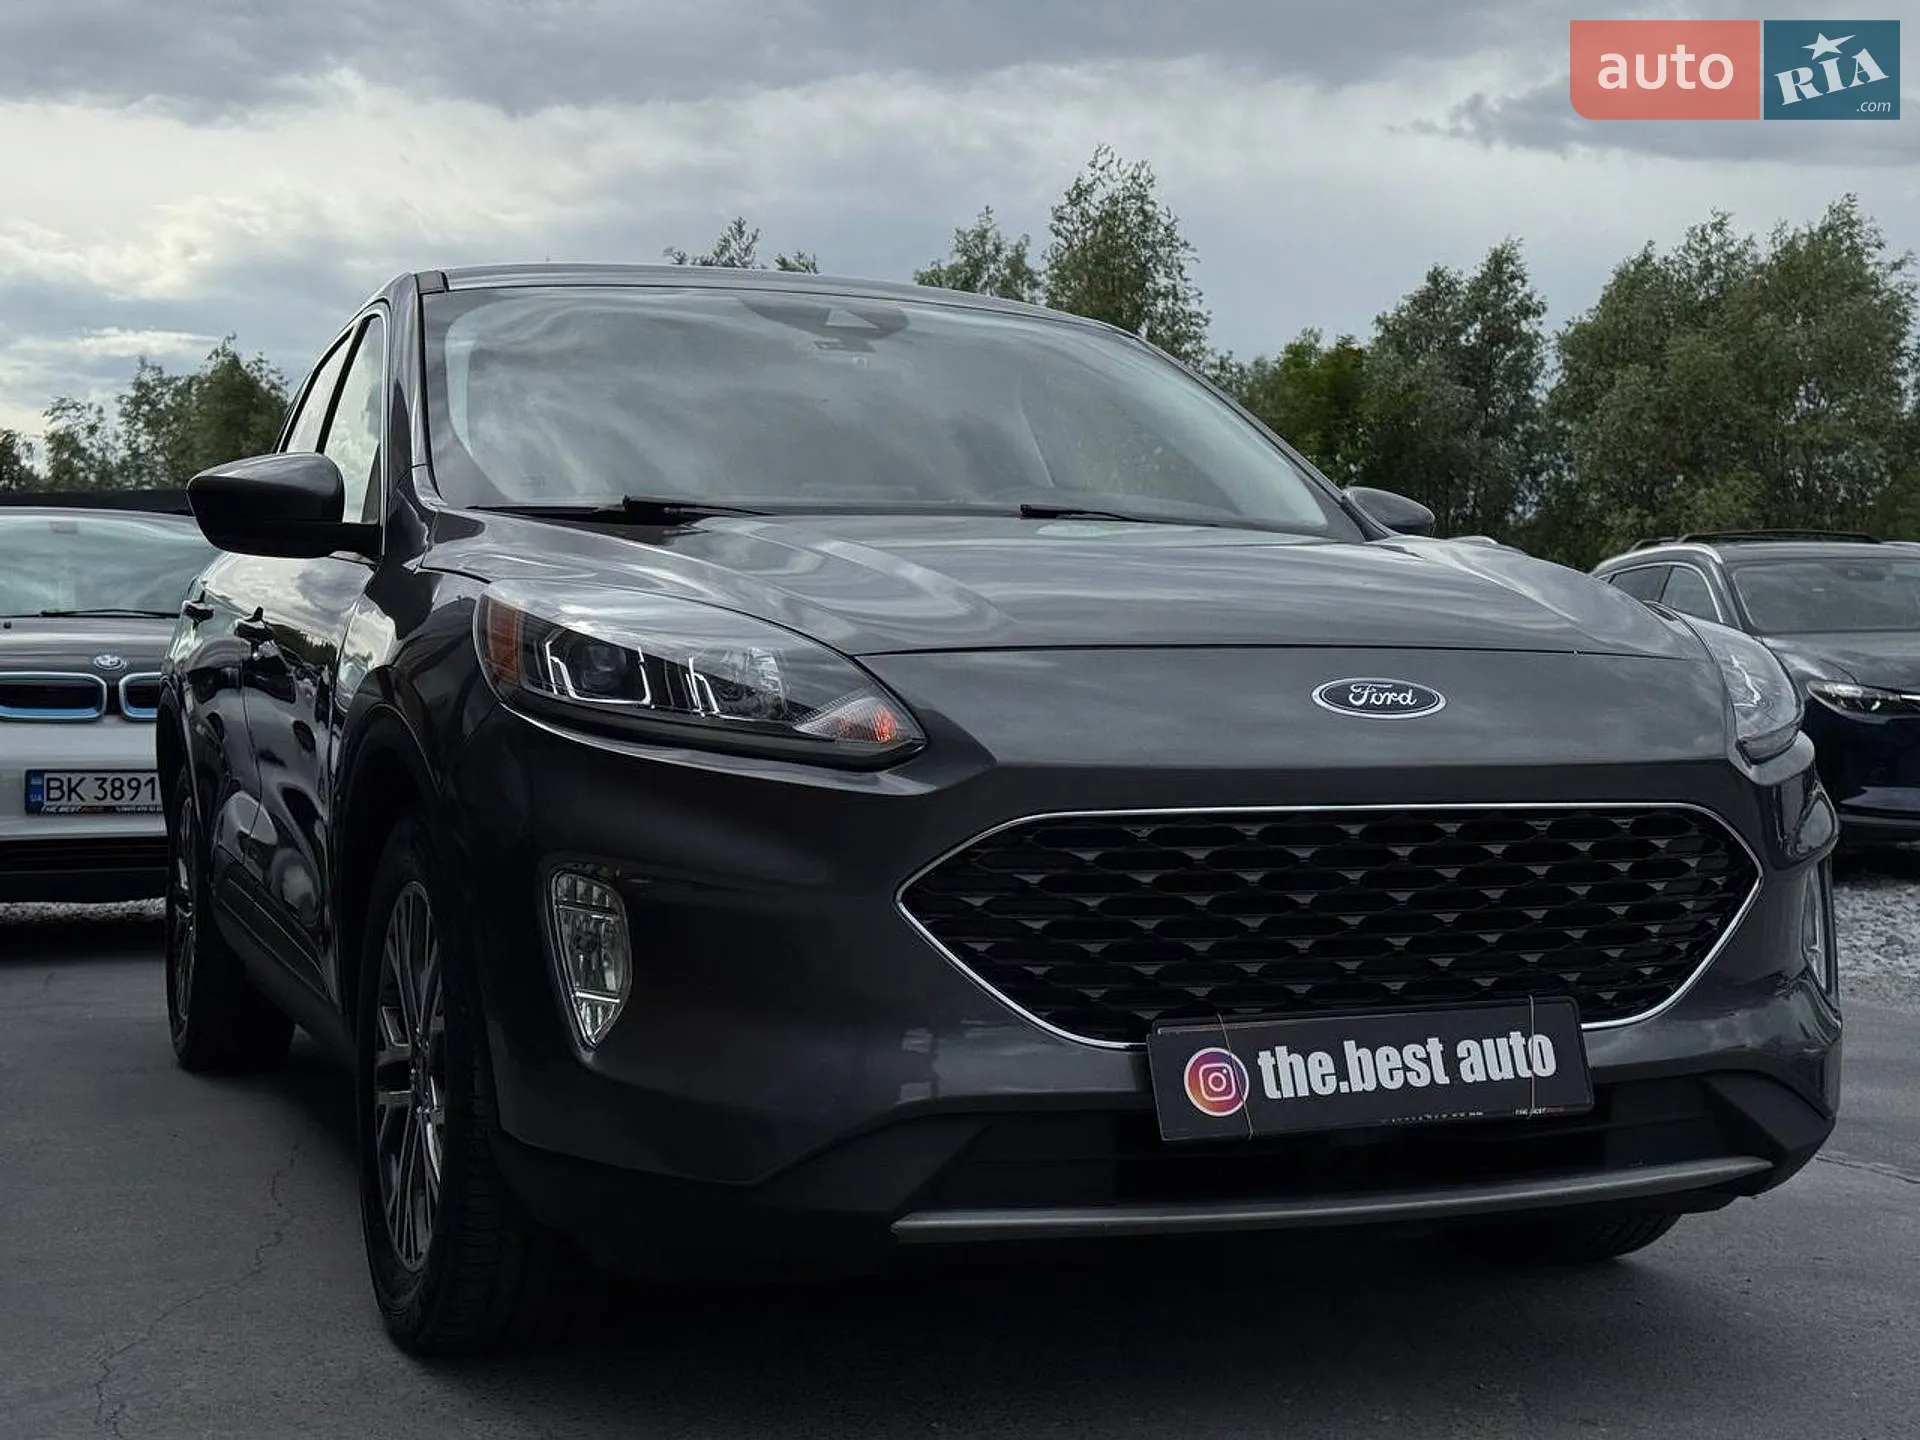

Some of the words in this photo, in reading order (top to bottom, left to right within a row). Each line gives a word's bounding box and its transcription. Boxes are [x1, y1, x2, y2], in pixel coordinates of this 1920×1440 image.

[1348, 682, 1417, 706] Ford
[46, 777, 87, 802] BK
[93, 777, 157, 801] 3891
[1257, 1037, 1449, 1100] the.best
[1456, 1031, 1557, 1083] auto
